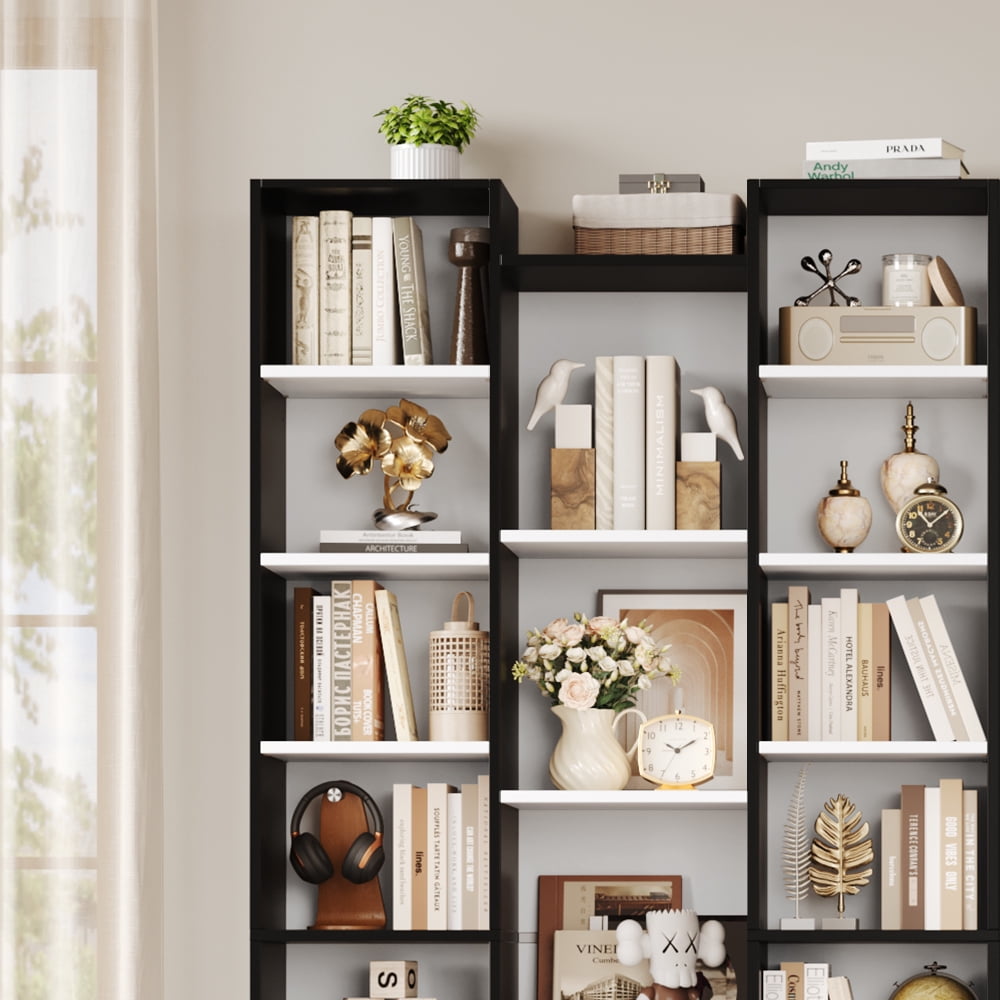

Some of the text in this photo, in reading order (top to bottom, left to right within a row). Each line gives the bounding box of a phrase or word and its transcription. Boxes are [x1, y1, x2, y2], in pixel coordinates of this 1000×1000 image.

[813, 162, 848, 173] Andy
[886, 145, 926, 153] PRADA
[398, 235, 417, 342] YOUNG THE SHACK
[353, 593, 362, 643] CHAPMAN
[365, 603, 374, 634] CALLUM
[334, 587, 351, 736] БОРИС ПАСТЕРНАК
[775, 629, 786, 721] Arianna Huffington
[861, 660, 869, 697] BAUHAUS
[876, 666, 885, 691] lines.
[845, 663, 853, 712] ALEXANDRA
[363, 689, 373, 735] BOOK COVER
[415, 851, 424, 876] lines.
[945, 816, 958, 891] GOOD VIBES ONLY
[965, 835, 975, 900] IN THE CITY
[378, 972, 397, 988] S
